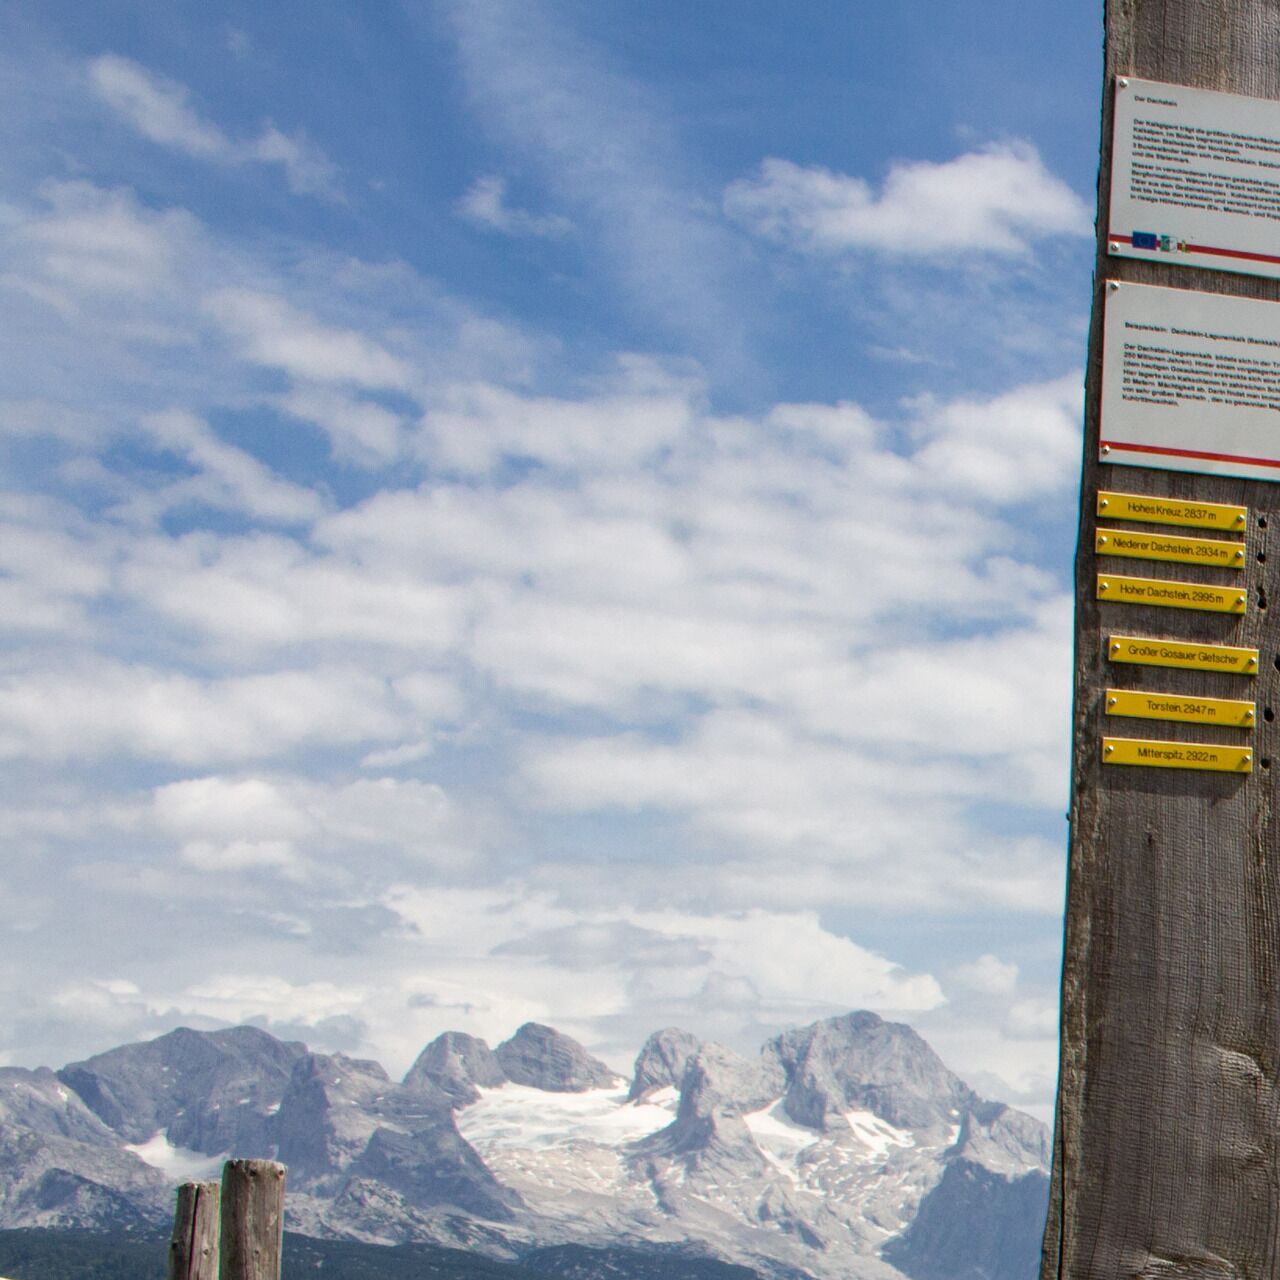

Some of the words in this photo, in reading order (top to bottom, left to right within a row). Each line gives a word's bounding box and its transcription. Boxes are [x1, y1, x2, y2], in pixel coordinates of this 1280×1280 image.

[1128, 502, 1155, 514] Hohes
[1185, 508, 1207, 519] 2837
[1113, 538, 1149, 550] Niederer
[1196, 546, 1218, 557] 2934
[1120, 584, 1146, 596] Hoher
[1193, 592, 1215, 603] 2995
[1128, 645, 1158, 657] Großer
[1160, 649, 1197, 660] Gosauer
[1199, 652, 1239, 664] Gletscher
[1184, 704, 1206, 715] 2947
[1187, 751, 1208, 762] 2922
